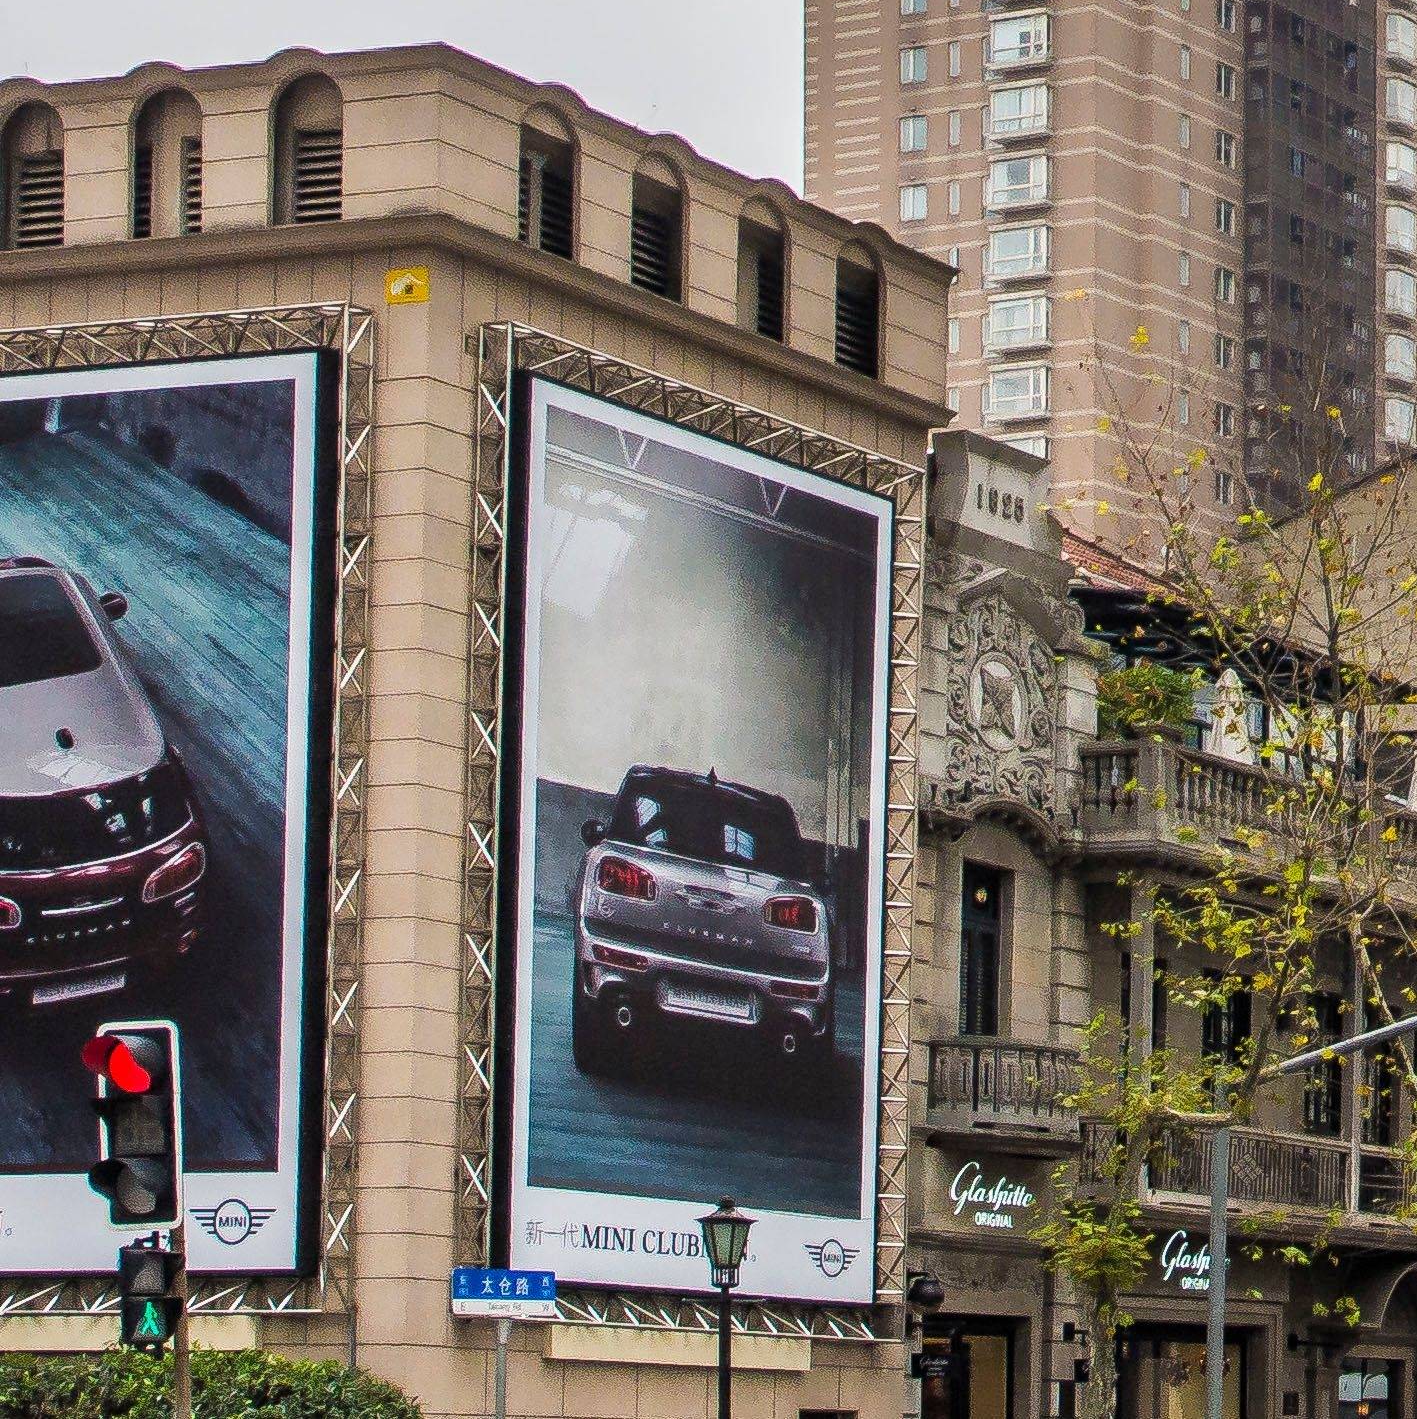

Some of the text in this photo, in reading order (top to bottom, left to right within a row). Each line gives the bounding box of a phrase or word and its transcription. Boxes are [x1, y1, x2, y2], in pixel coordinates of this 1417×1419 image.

[975, 1211, 1013, 1228] ORIGINAL
[525, 1221, 579, 1246] 新一代
[581, 1223, 635, 1252] MINI
[481, 1275, 529, 1296] 太仓路
